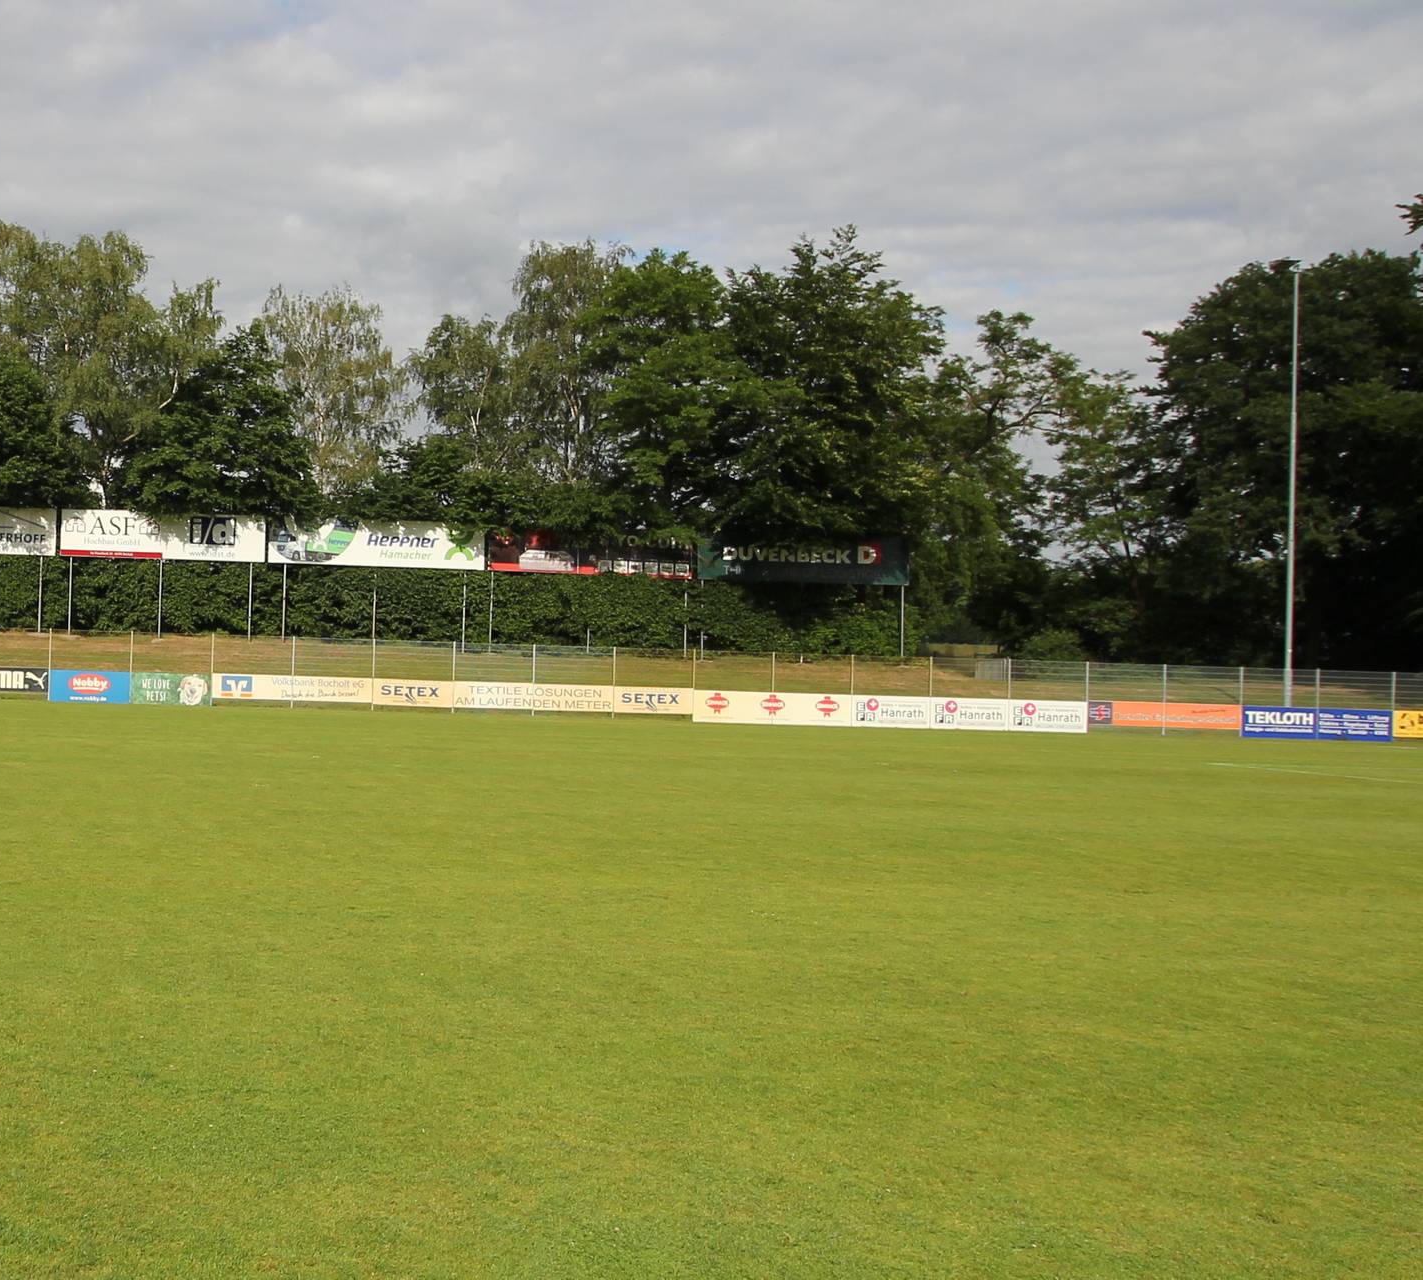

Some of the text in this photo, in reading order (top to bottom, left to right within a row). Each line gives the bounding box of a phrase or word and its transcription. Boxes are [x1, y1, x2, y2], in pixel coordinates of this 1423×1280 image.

[89, 514, 138, 536] ASF
[379, 549, 432, 560] Hamacher
[722, 545, 852, 564] DUVENBECK
[142, 678, 171, 690] WE LOVE
[272, 677, 314, 686] Volksbank
[318, 679, 350, 688] Bocholt
[381, 685, 439, 698] SETEX
[468, 685, 522, 696] TEXTILE
[455, 697, 611, 709] AM LAUFENDEN METER
[622, 693, 679, 704] SETEX
[881, 708, 924, 718] Hanrath
[960, 711, 1002, 720] Hanrath
[1038, 712, 1081, 722] Hanrath
[1245, 711, 1314, 725] TEKLOTH
